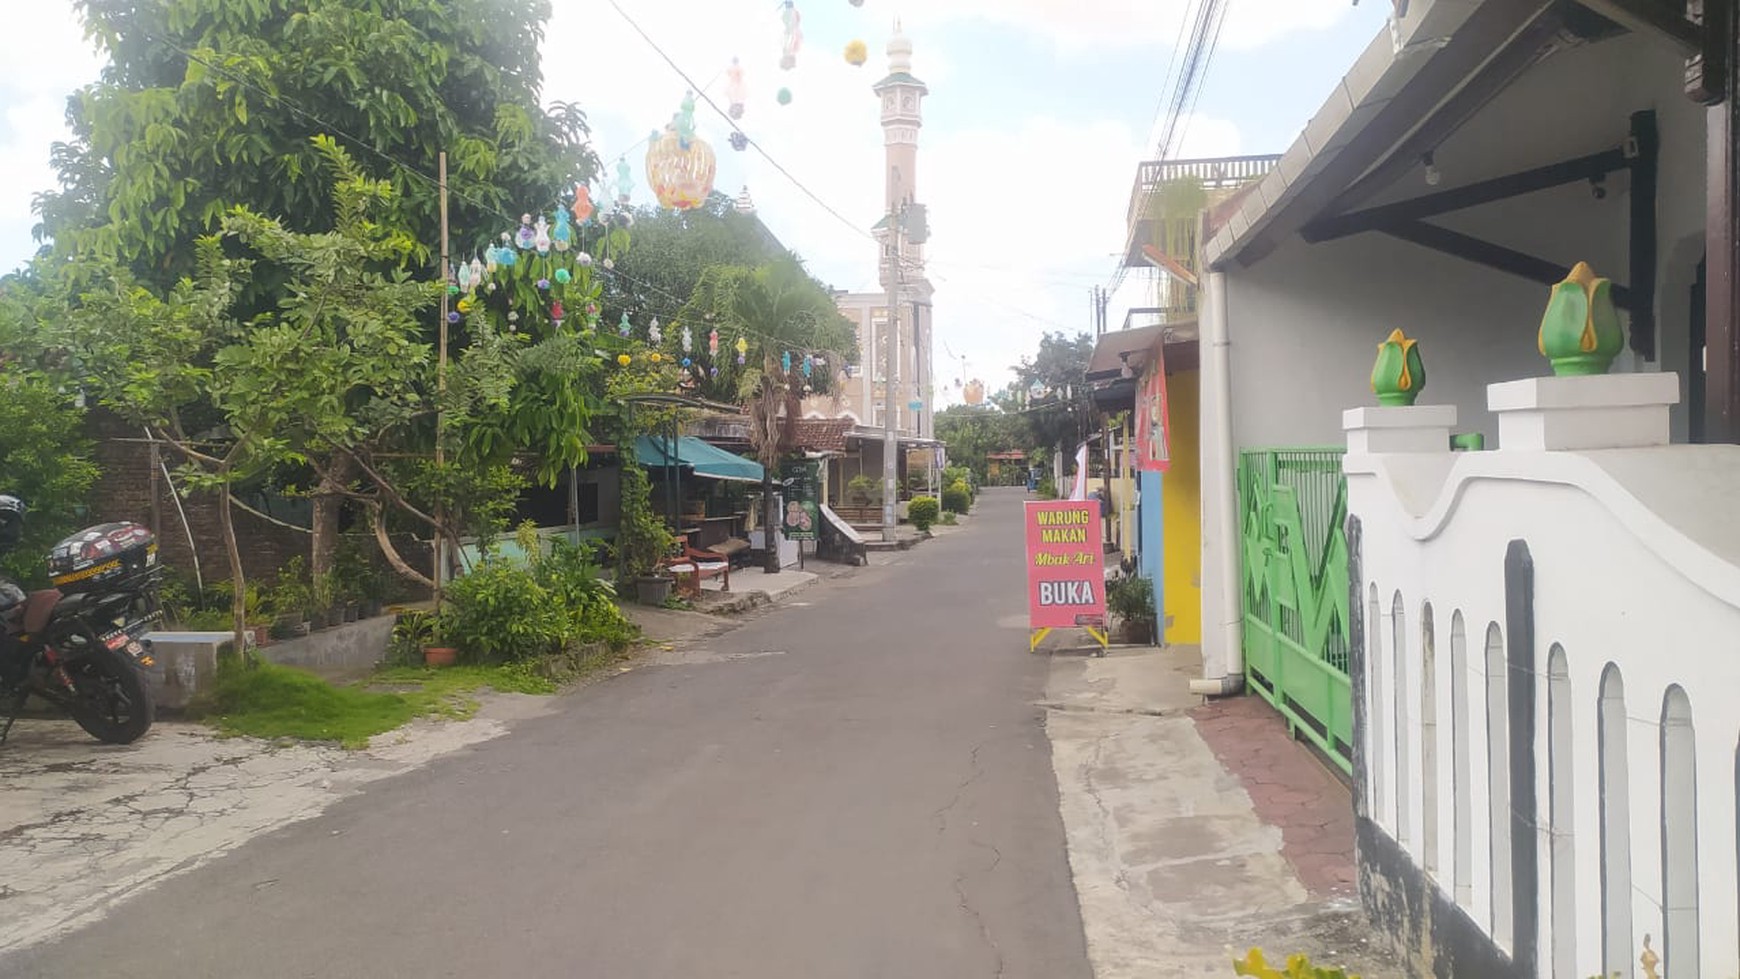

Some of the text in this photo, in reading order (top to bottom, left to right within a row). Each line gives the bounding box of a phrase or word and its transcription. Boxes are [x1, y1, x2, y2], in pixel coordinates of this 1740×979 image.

[1037, 510, 1089, 525] WARUNG
[1042, 528, 1087, 543] MAKAN
[1035, 551, 1094, 566] Mbak Ari
[1039, 580, 1095, 606] BUKA
